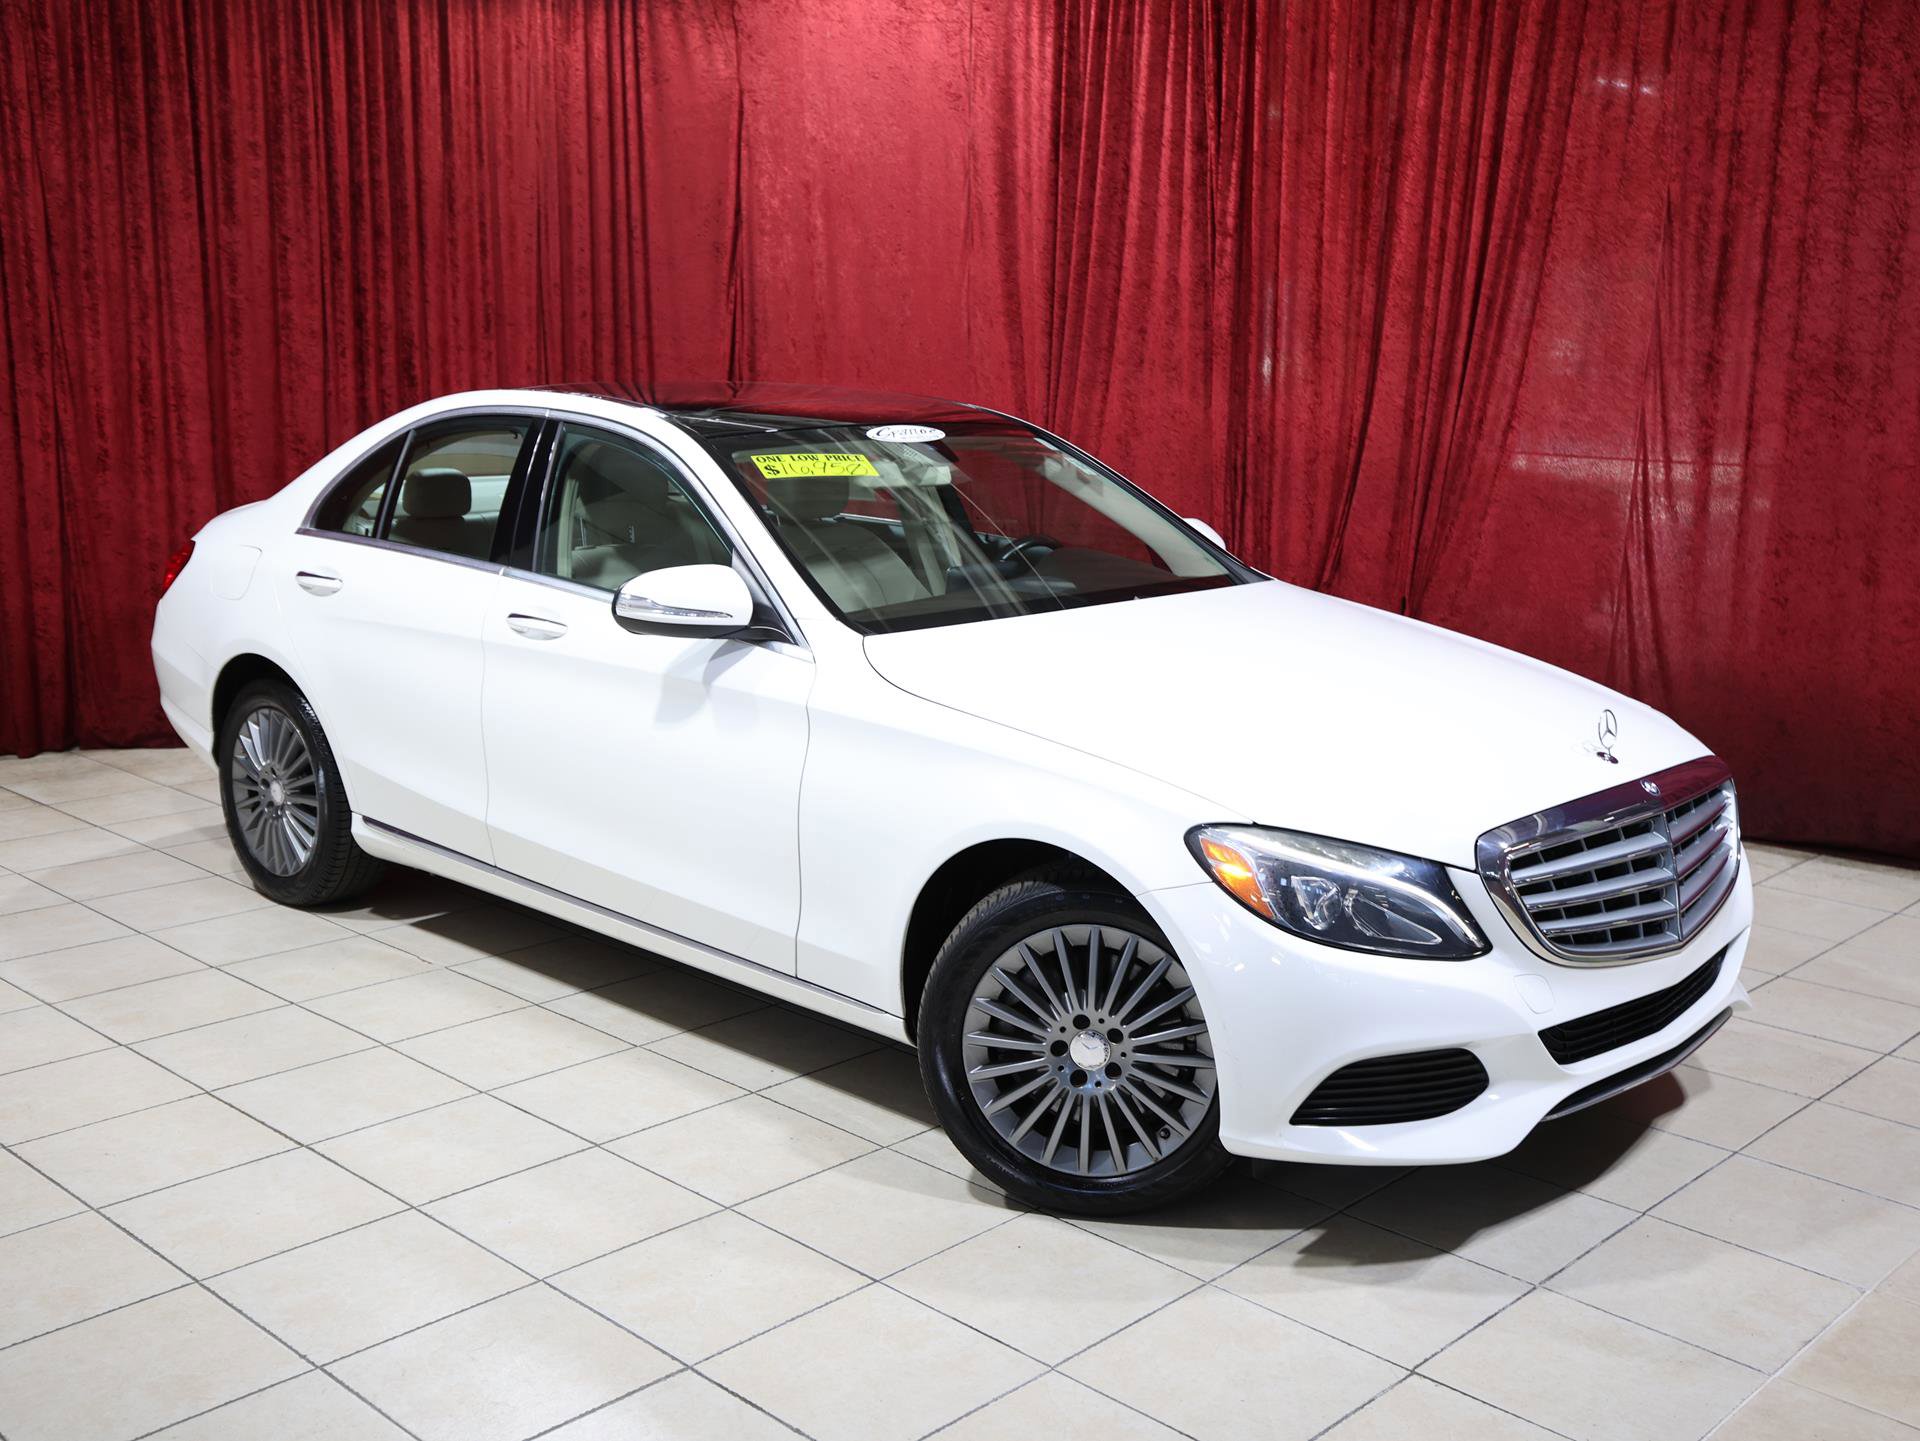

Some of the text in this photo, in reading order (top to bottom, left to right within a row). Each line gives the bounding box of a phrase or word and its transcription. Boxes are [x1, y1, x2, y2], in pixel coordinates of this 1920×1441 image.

[756, 454, 862, 463] ONE LOW PRICE
